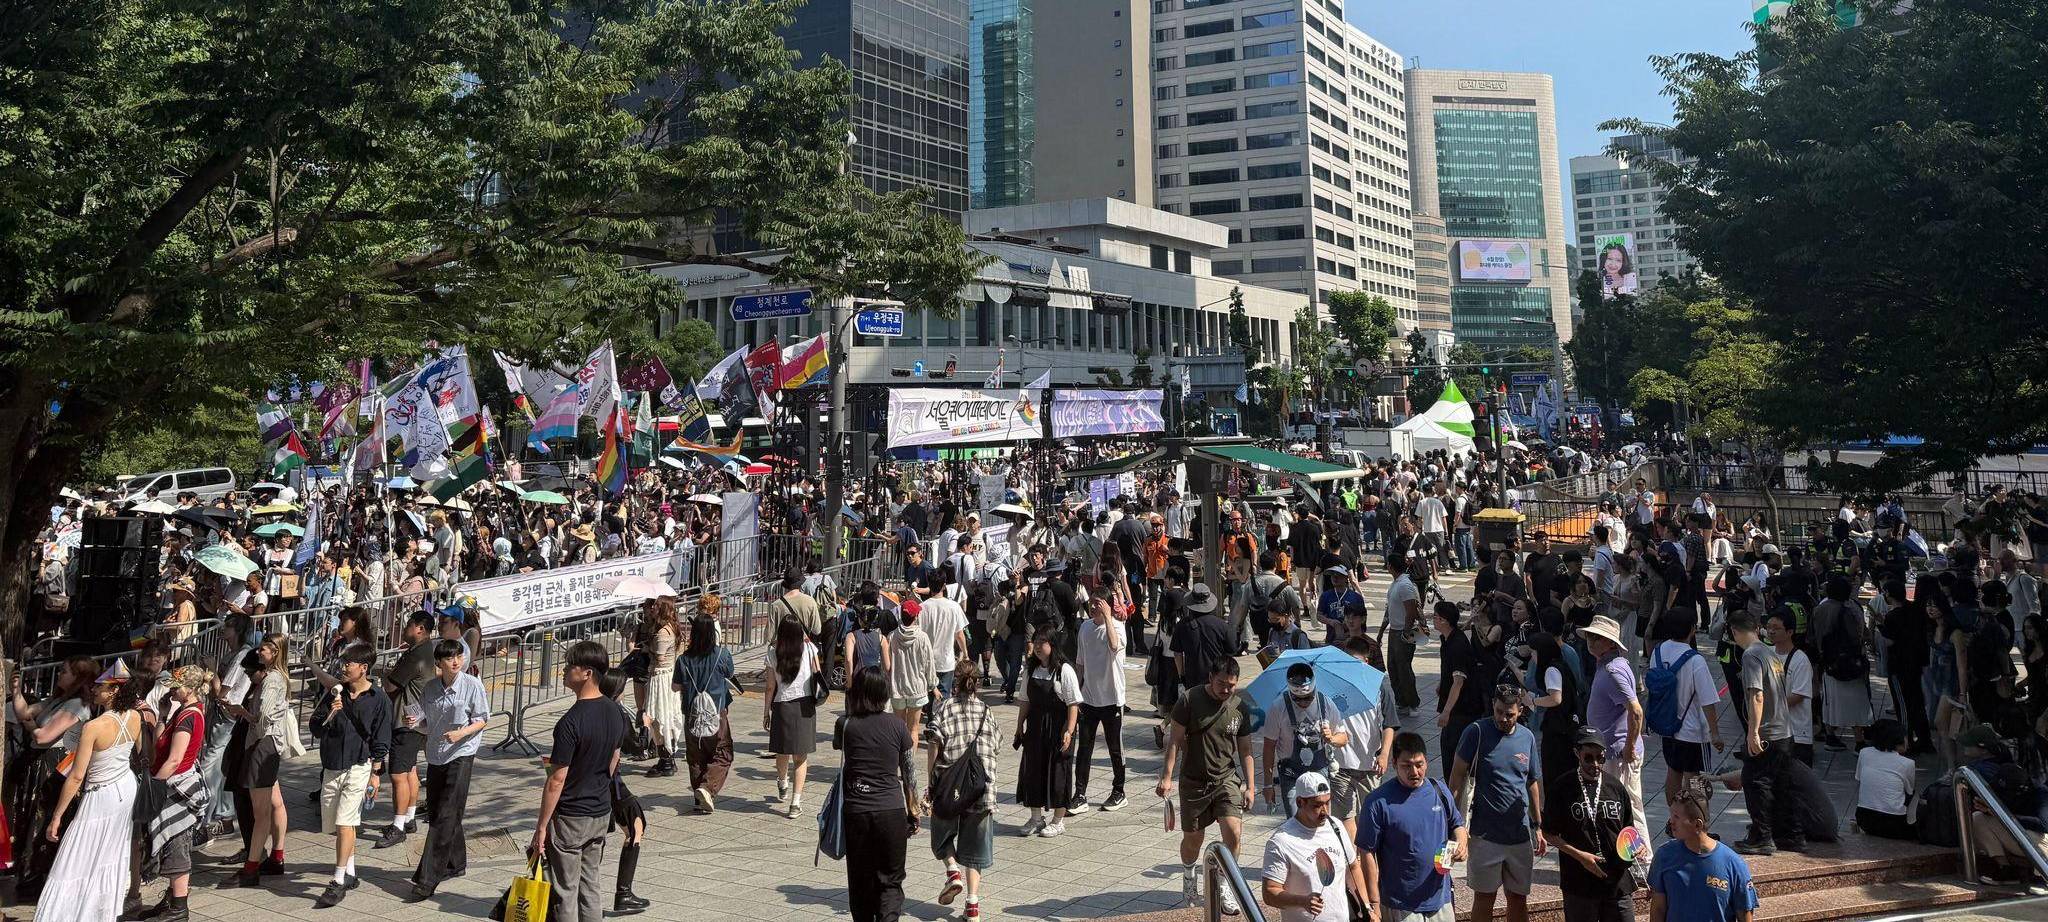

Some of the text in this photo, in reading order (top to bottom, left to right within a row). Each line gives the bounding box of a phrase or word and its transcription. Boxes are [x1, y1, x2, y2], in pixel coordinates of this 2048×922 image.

[757, 295, 788, 309] 청계천로
[744, 308, 802, 318] Cheonggyecheon-ro
[873, 312, 901, 324] 우정국로
[865, 324, 901, 334] Ujeongguk-ro
[511, 582, 542, 603] 종각역
[545, 578, 566, 598] 근처,
[524, 590, 571, 615] 횡단보도를
